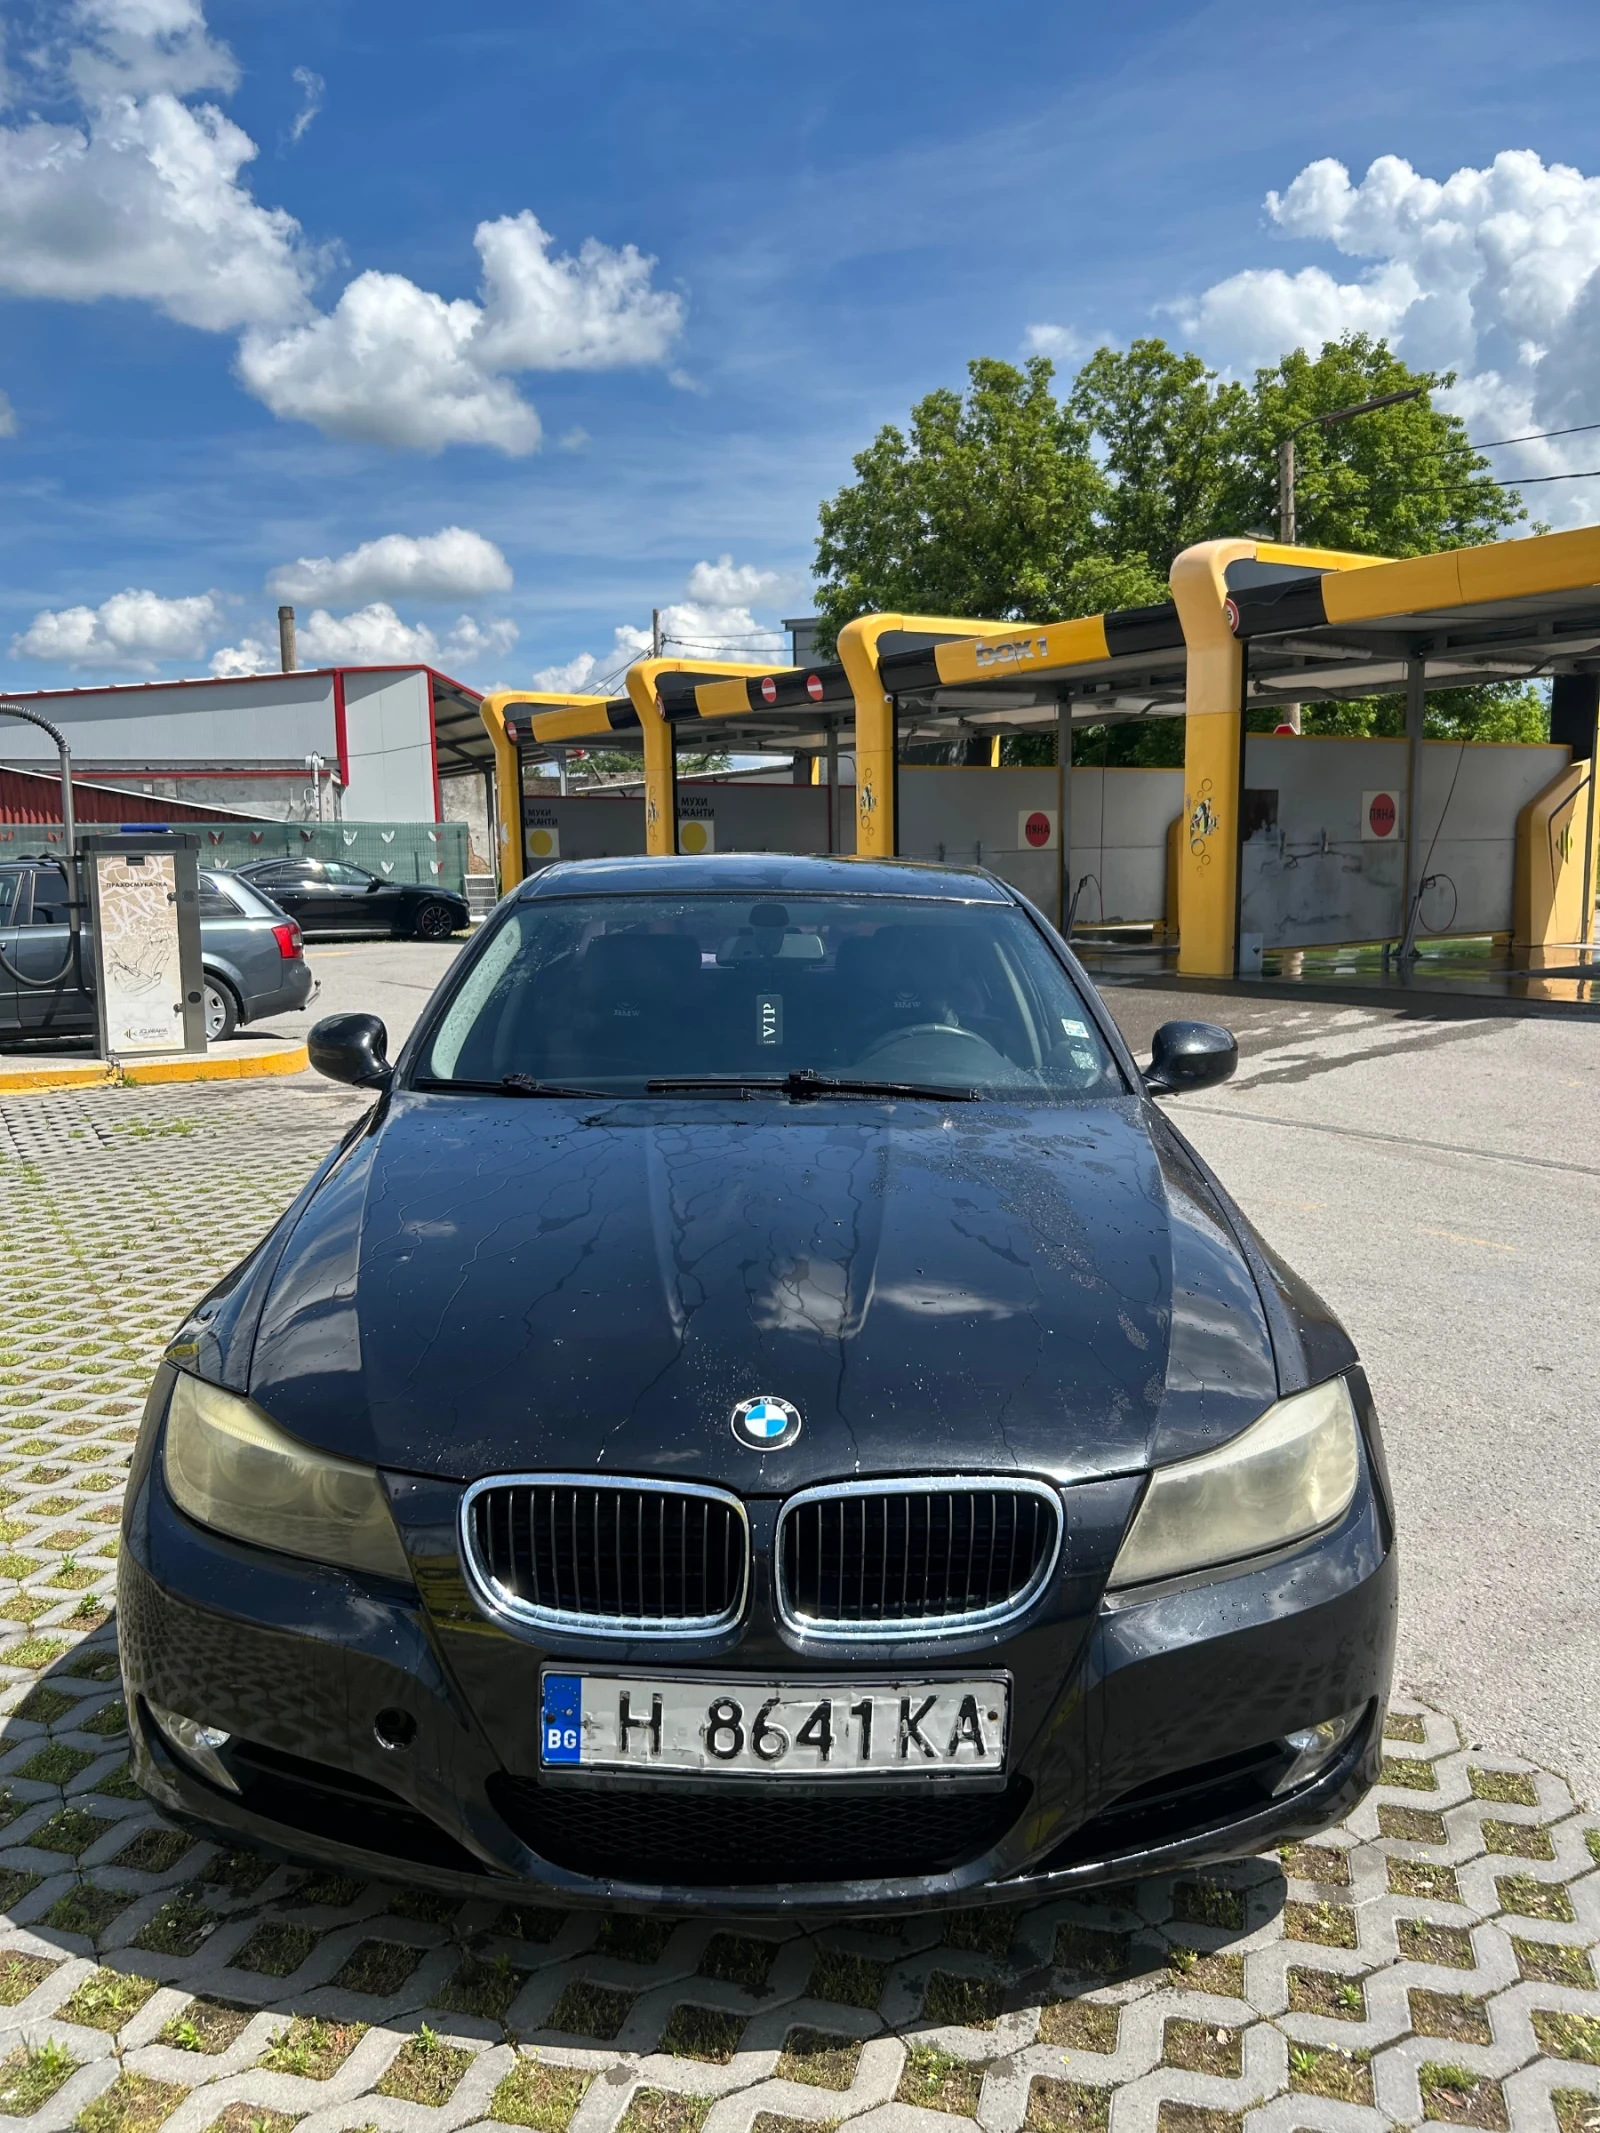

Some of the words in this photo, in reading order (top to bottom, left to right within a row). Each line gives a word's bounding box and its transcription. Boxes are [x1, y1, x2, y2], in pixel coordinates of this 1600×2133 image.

[976, 639, 1034, 667] box
[1036, 636, 1048, 657] 1
[680, 797, 708, 807] МУХИ
[527, 808, 552, 818] МУХИ
[1369, 808, 1396, 821] ПЯНА
[1025, 824, 1051, 836] ПЯНА
[763, 1002, 776, 1038] VIP
[619, 1690, 664, 1755] H
[704, 1695, 874, 1762] 8641
[899, 1693, 987, 1758] KA
[547, 1728, 578, 1749] BG
